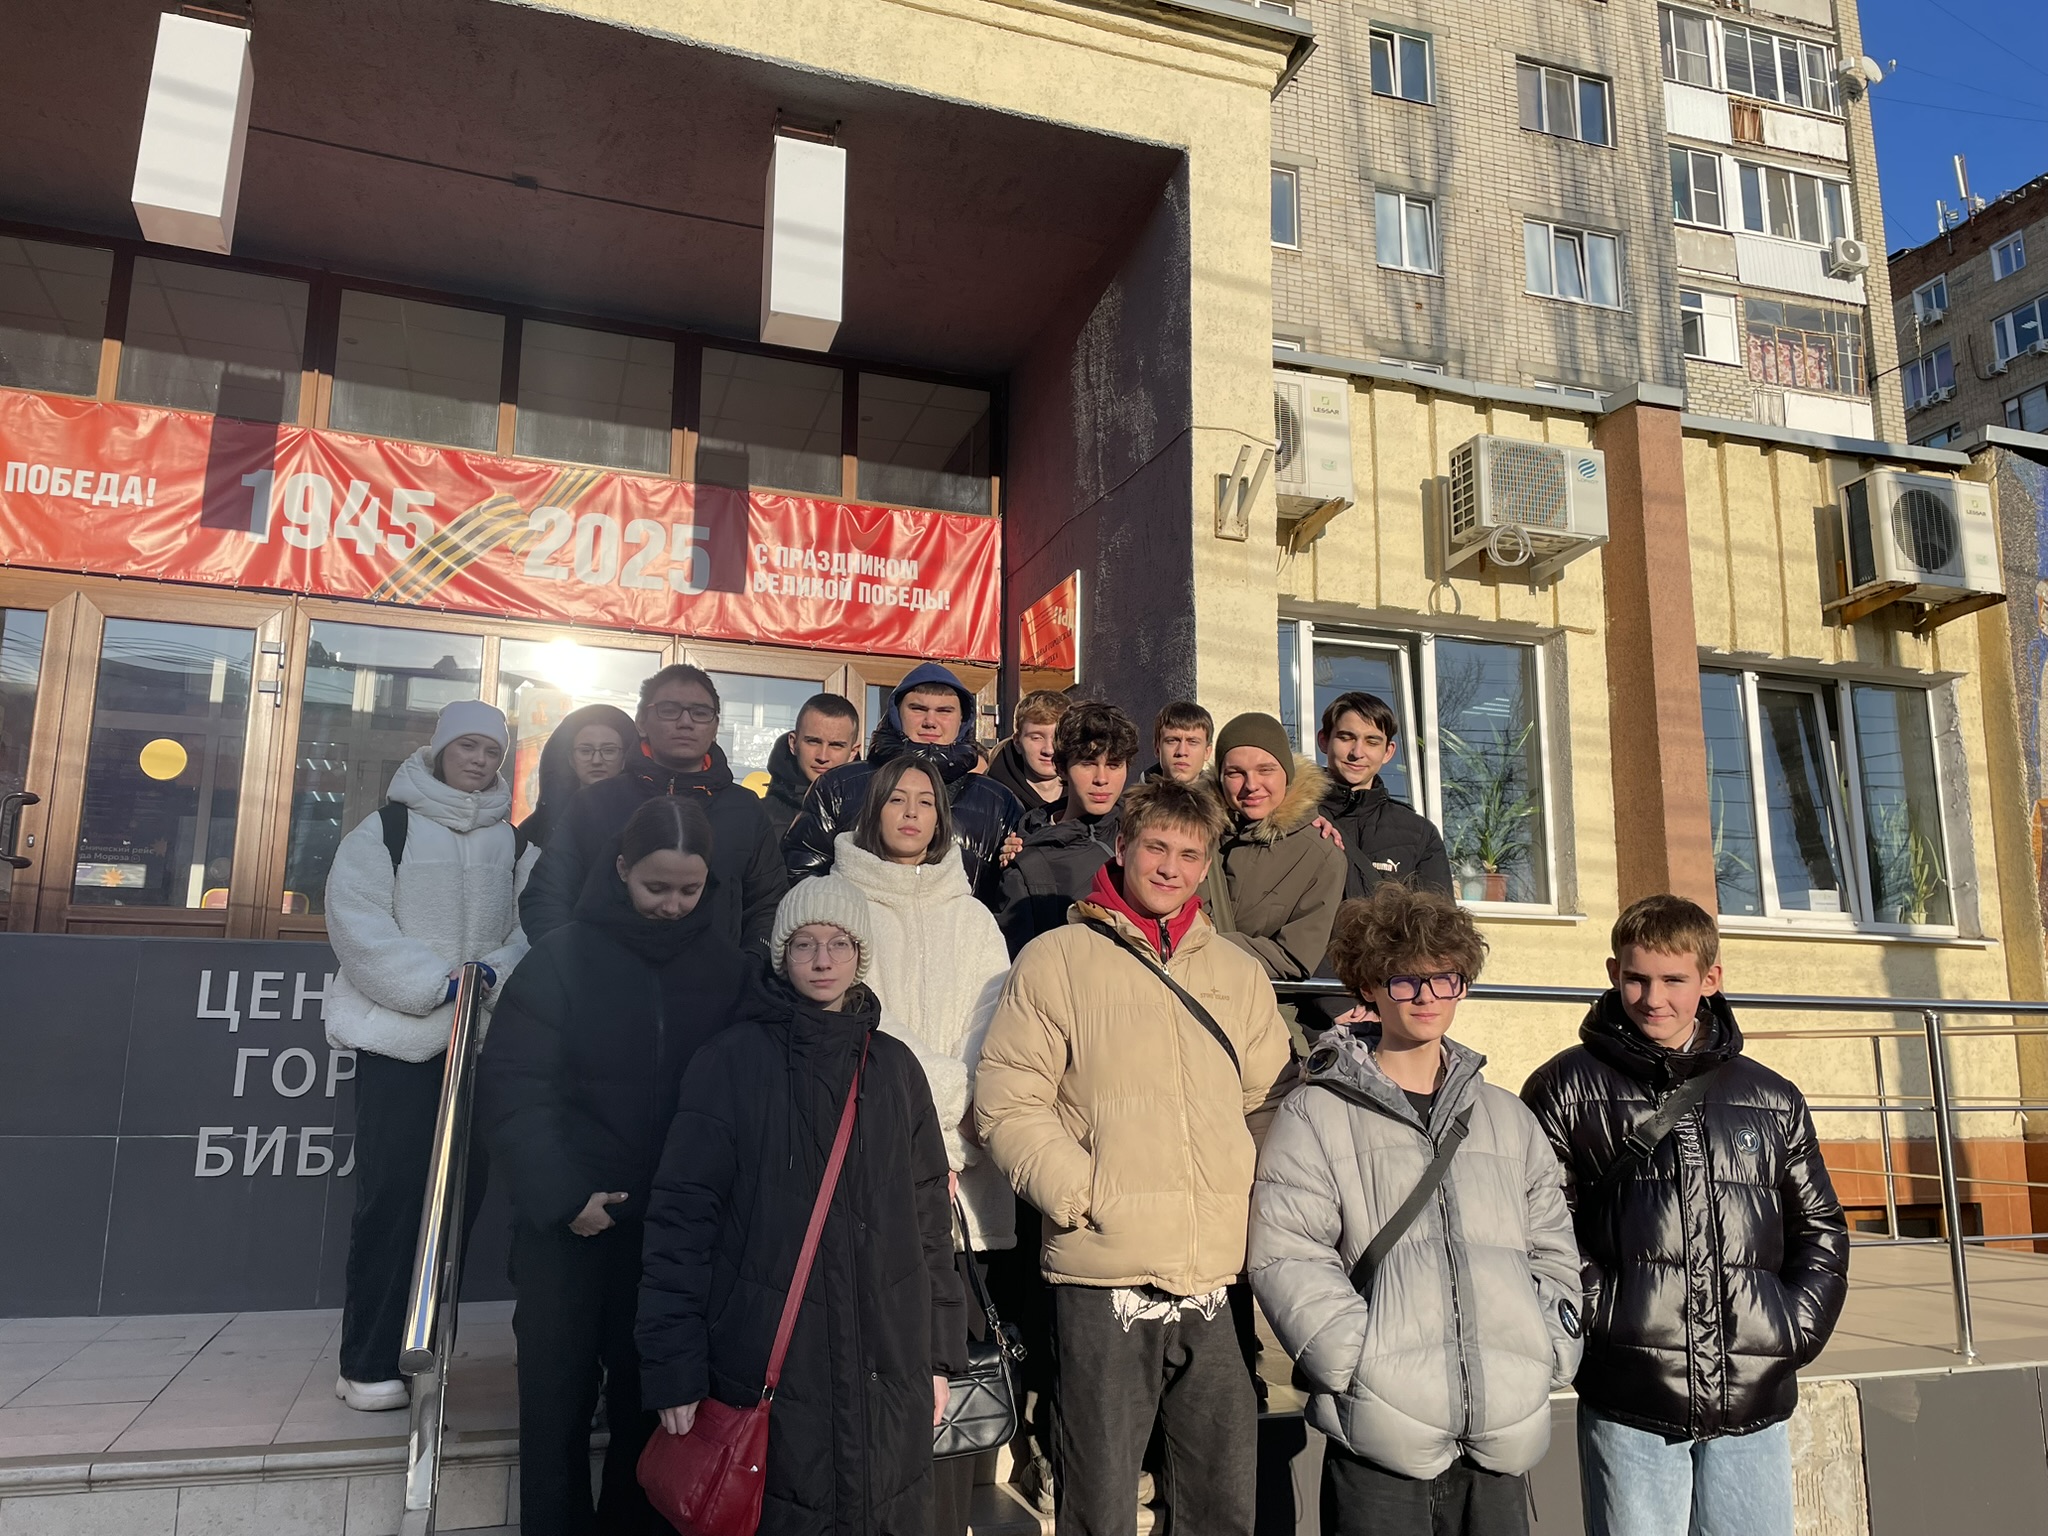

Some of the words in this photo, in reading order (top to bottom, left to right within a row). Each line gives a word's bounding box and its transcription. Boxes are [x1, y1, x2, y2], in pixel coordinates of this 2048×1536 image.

[1313, 406, 1340, 415] LESSAR
[4, 461, 156, 508] ПОБЕДА!
[240, 467, 437, 559] 1945
[523, 505, 711, 596] 2025
[754, 543, 768, 566] С
[775, 544, 919, 581] ПРАЗДНИКОМ
[752, 571, 852, 602] ВЕЛИКОЙ
[858, 582, 951, 613] ПОБЕДЫ!
[196, 970, 335, 1032] ЦЕН
[233, 1048, 357, 1098] ГОР
